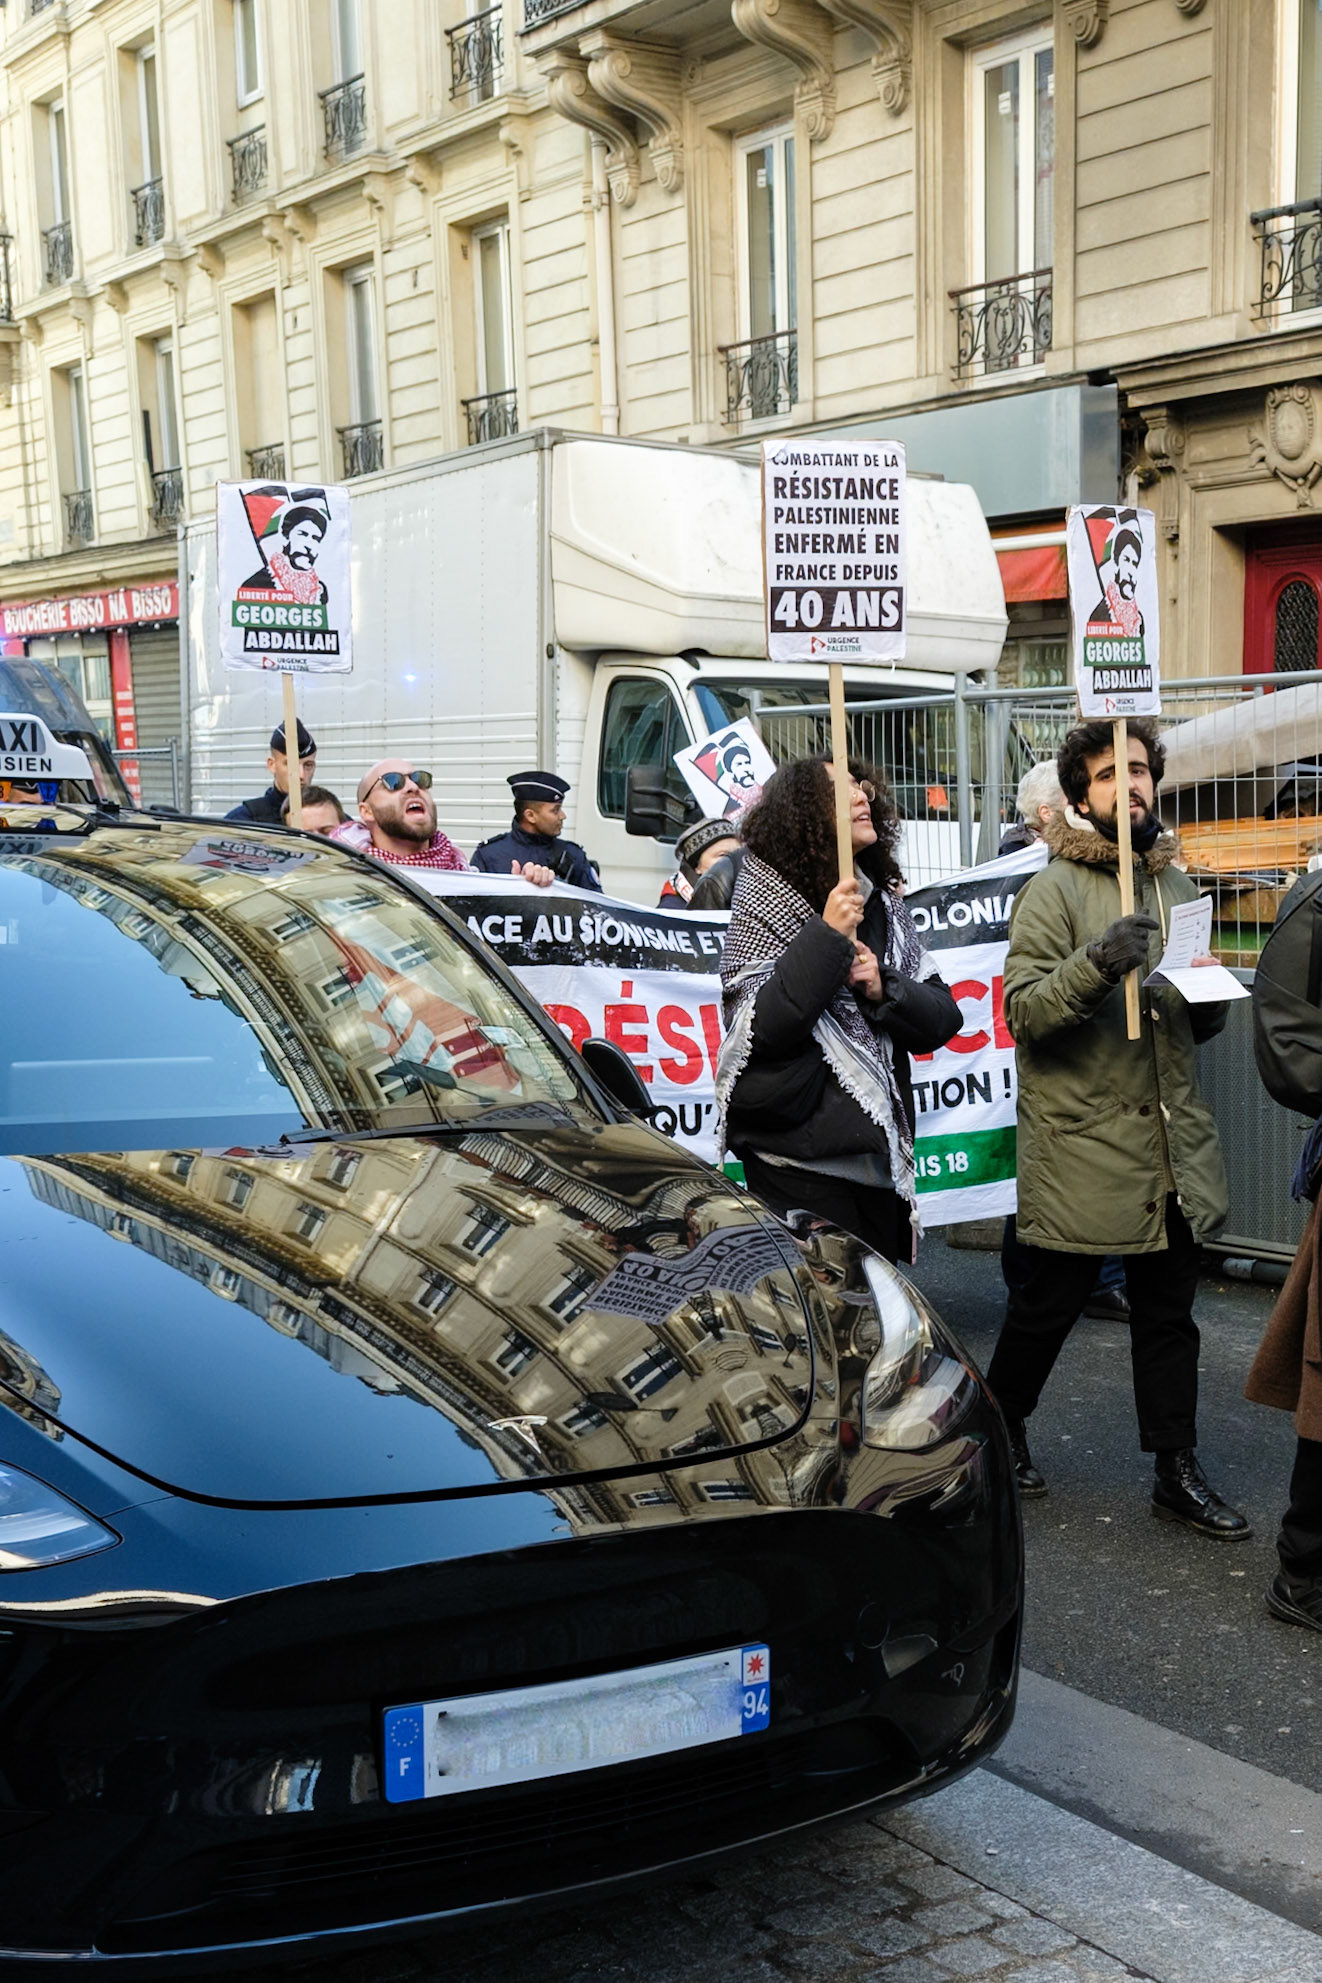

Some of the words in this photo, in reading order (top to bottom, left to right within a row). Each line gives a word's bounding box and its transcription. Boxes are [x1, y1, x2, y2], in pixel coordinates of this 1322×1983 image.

[864, 454, 880, 467] DE
[884, 455, 899, 467] LA
[773, 470, 899, 500] RÉSISTANCE
[774, 507, 900, 525] PALESTINIENNE
[775, 527, 867, 554] ENFERMÉ
[875, 533, 899, 554] EN
[776, 564, 837, 580] FRANCE
[843, 564, 898, 580] DEPUIS
[271, 592, 294, 603] POUR
[3, 600, 67, 634] BOUCHERIE
[69, 597, 104, 626] BISSO
[236, 605, 323, 627] GEORGES
[774, 590, 824, 628] 40
[830, 590, 899, 628] ANS
[245, 631, 337, 651] ABDALLAH
[1086, 641, 1142, 662] GEORGES
[1094, 669, 1151, 690] ABDALLAH
[530, 914, 574, 943] AU
[695, 930, 728, 955] ET
[911, 1071, 993, 1113] TION
[1002, 1067, 1012, 1099] !
[649, 1103, 720, 1138] QU'
[944, 1151, 969, 1174] 18
[743, 1687, 769, 1719] 94
[400, 1757, 411, 1776] F
